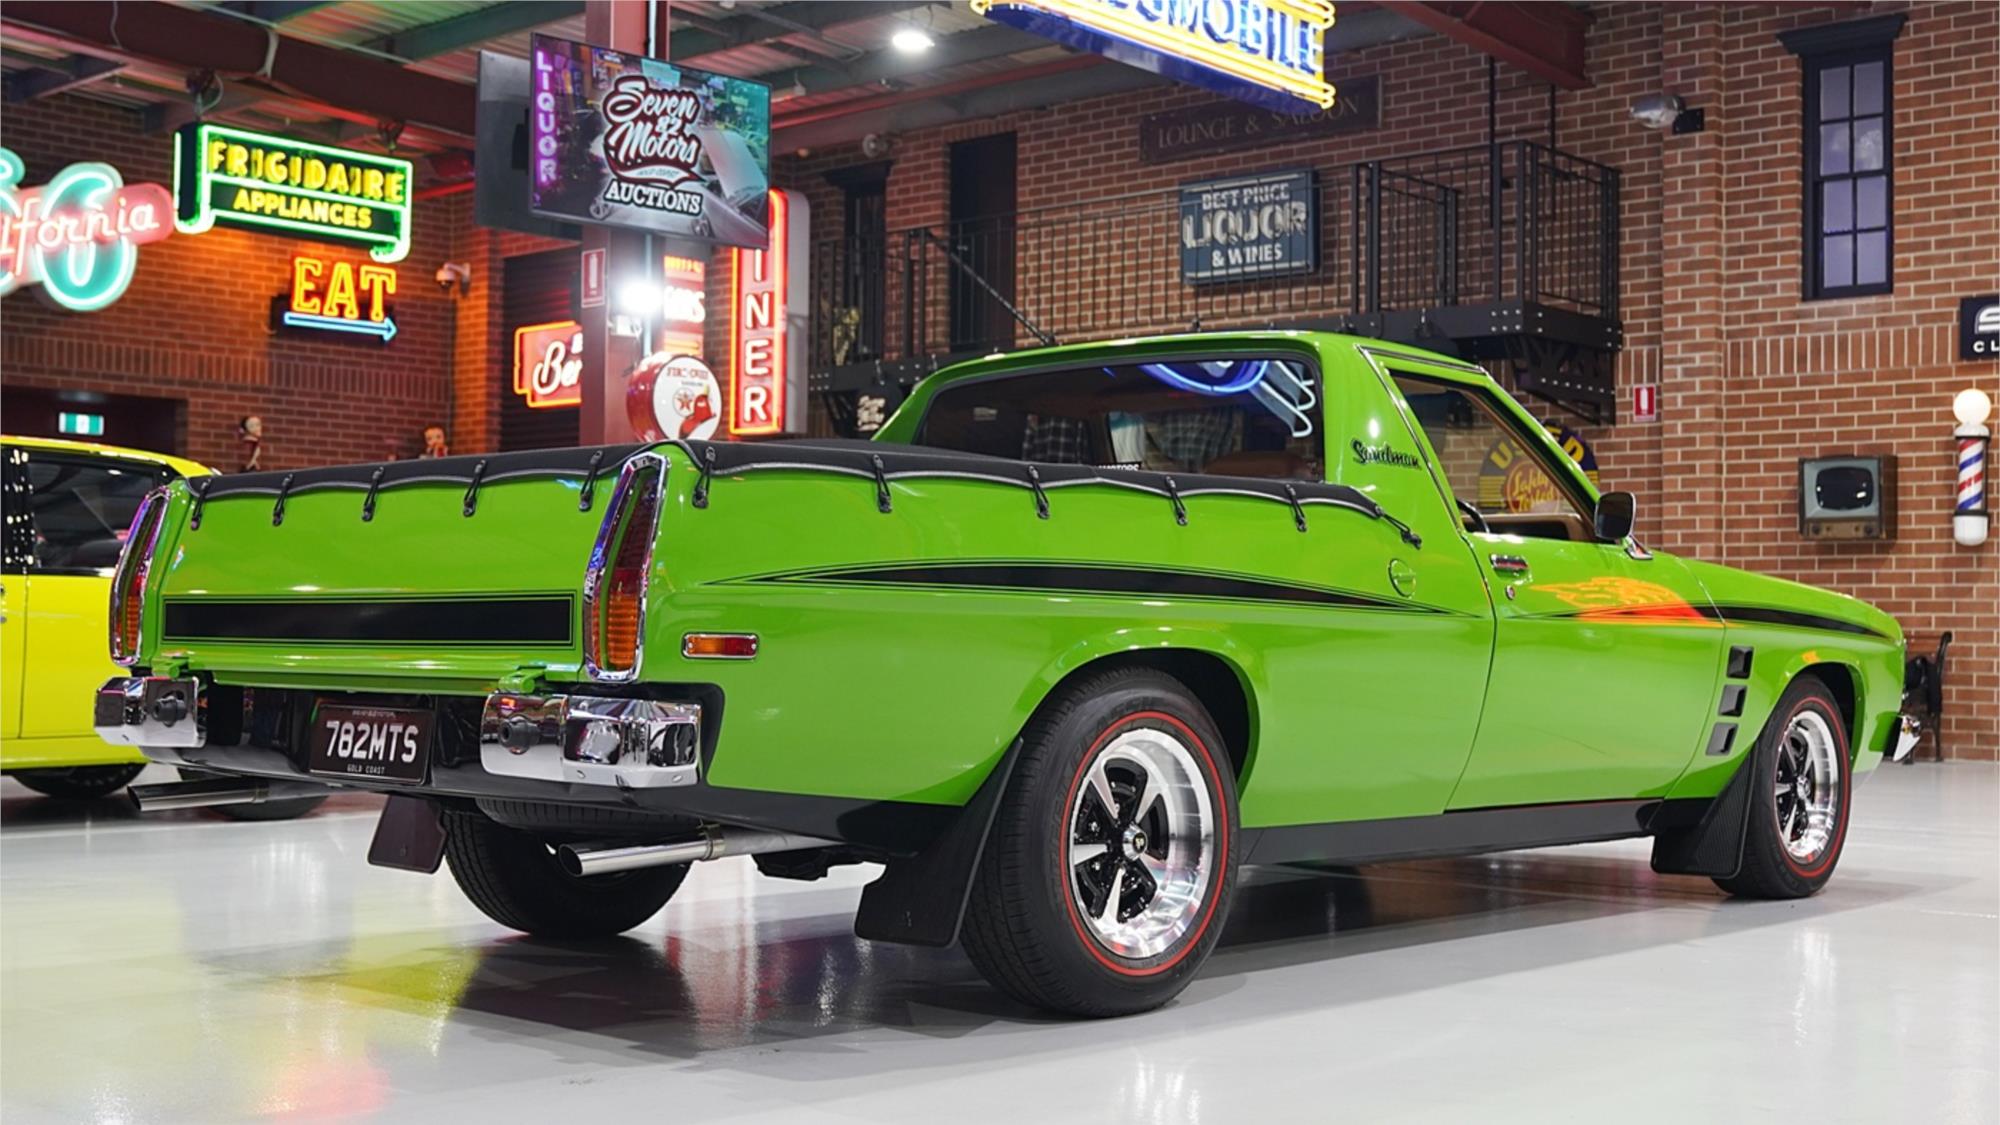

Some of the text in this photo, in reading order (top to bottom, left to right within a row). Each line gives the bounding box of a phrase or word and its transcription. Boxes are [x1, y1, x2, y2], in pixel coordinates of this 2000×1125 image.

[1107, 0, 1322, 75] MOBILE
[537, 50, 558, 183] LIQUOR
[606, 80, 697, 123] Seven
[609, 120, 698, 163] Motors
[655, 115, 683, 136] 82
[1158, 115, 1237, 149] LOUNGE
[1245, 114, 1262, 135] &
[208, 140, 404, 204] FRIGIDAIRE
[233, 188, 372, 229] APPLIANCES
[606, 182, 700, 213] AUCTIONS
[1202, 183, 1290, 210] BEST PRICE
[1182, 201, 1307, 249] LIQUOR
[1212, 243, 1282, 267] & WINES
[292, 257, 397, 321] EAT
[743, 249, 772, 422] INER
[326, 720, 419, 763] 782MTS
